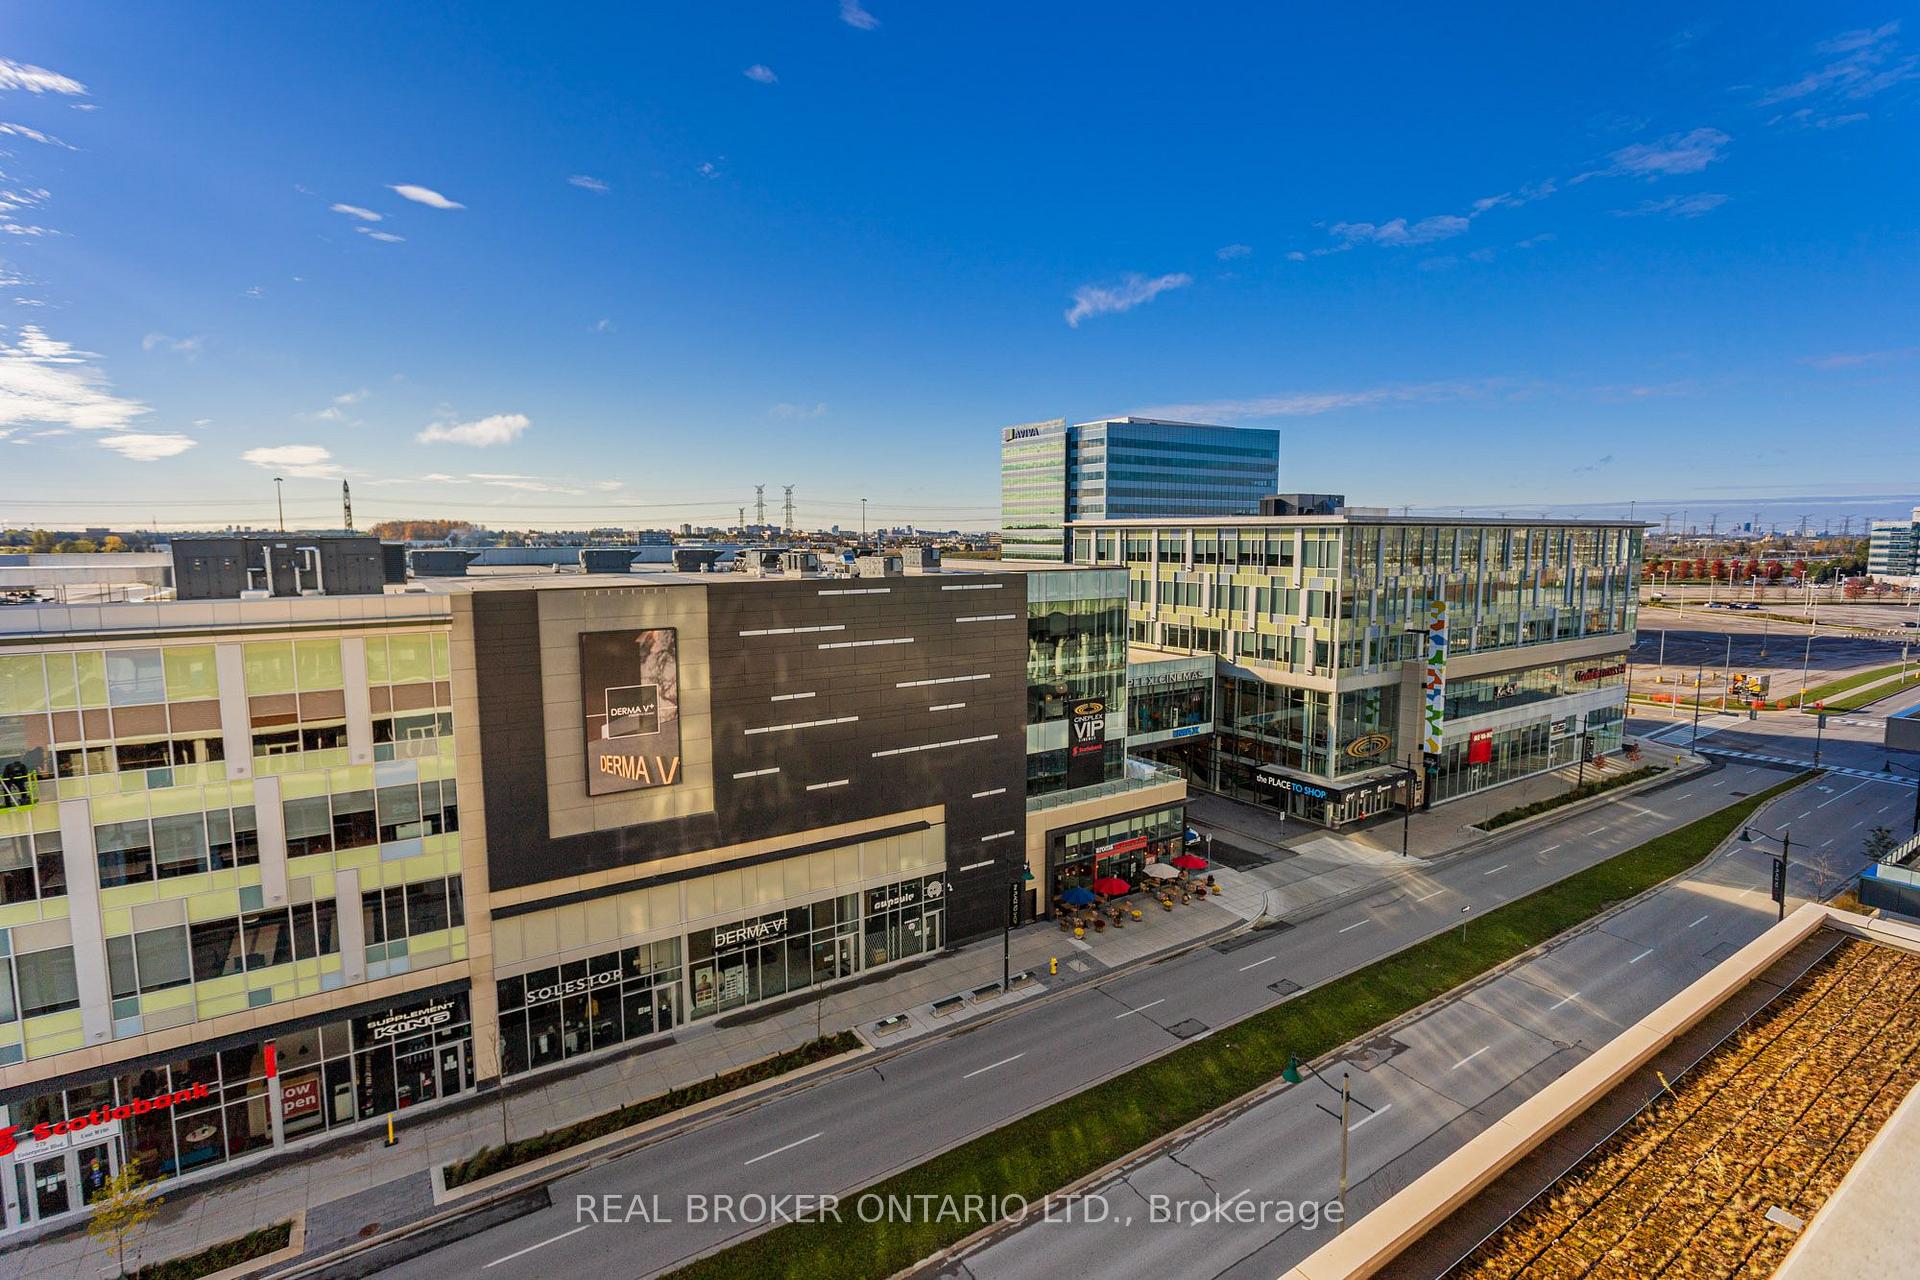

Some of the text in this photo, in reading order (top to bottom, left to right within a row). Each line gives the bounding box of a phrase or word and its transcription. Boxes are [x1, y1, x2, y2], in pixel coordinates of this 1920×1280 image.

[1015, 427, 1040, 439] AVIVA
[1159, 671, 1204, 684] CINEMAS
[610, 705, 642, 717] DERMA
[1073, 713, 1104, 723] CINEPLEX
[1073, 719, 1105, 739] VIP
[600, 755, 651, 784] DERMA
[1256, 773, 1327, 799] the PLACE TO SHOP
[715, 923, 770, 948] DERMA
[526, 969, 623, 1003] SOLESTOP
[367, 1001, 455, 1029] SUPPLEMENT
[374, 1011, 451, 1040] KING
[281, 1083, 311, 1099] ow
[32, 1081, 210, 1142] Scotiabank
[284, 1095, 316, 1114] pen
